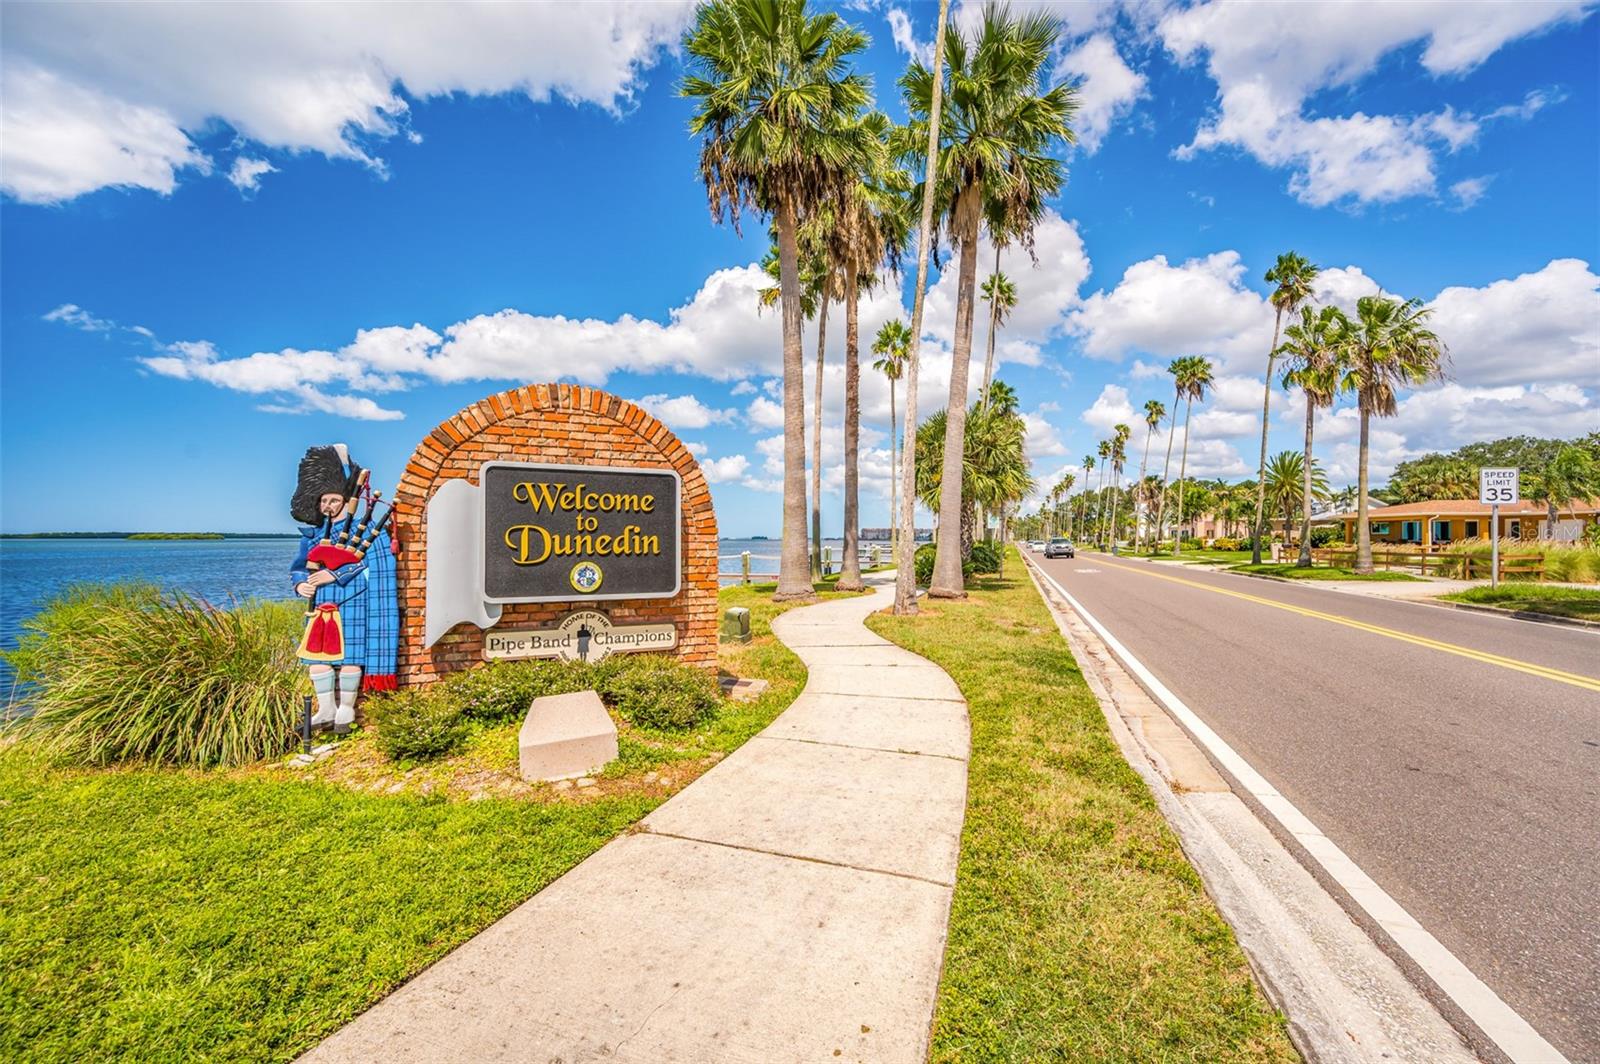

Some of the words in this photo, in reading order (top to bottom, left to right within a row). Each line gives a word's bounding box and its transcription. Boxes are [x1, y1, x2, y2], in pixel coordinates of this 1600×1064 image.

[512, 481, 656, 514] Welcome
[1486, 488, 1513, 501] 35
[575, 513, 599, 532] to
[504, 523, 661, 565] Dunedin
[562, 613, 584, 631] HOME
[597, 616, 610, 629] THE
[489, 637, 525, 653] Pipe
[531, 634, 571, 649] Band
[594, 629, 672, 646] Champions
